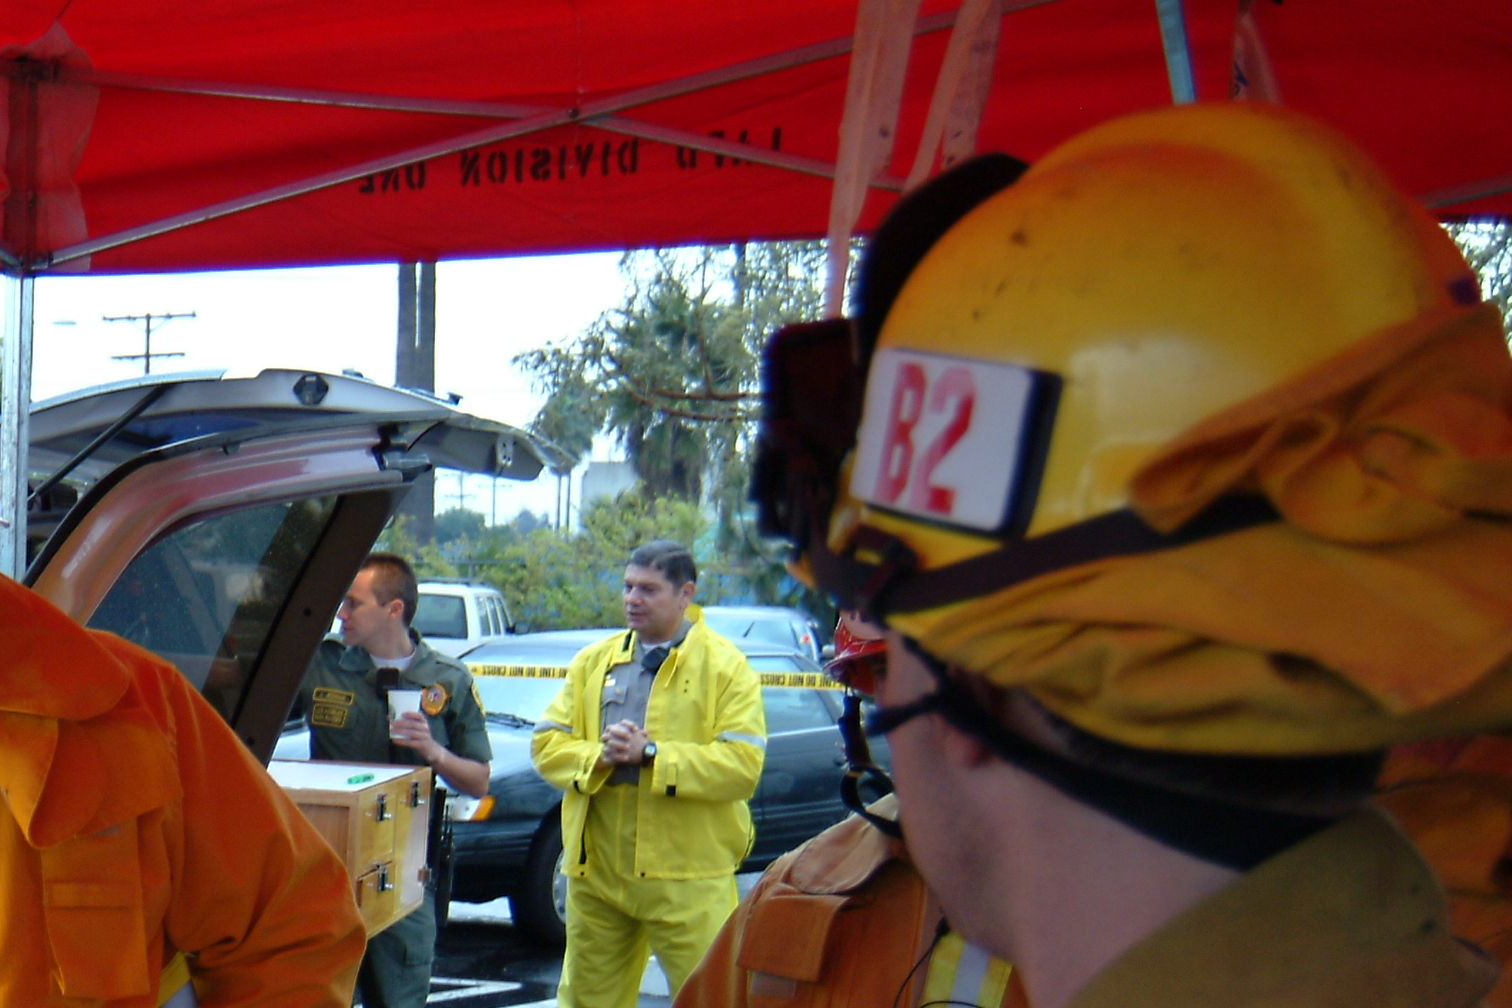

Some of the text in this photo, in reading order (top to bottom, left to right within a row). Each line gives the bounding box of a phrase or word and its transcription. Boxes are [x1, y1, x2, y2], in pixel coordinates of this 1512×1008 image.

[482, 665, 506, 676] CROSS
[508, 666, 524, 677] NOT
[760, 674, 785, 686] CROSS
